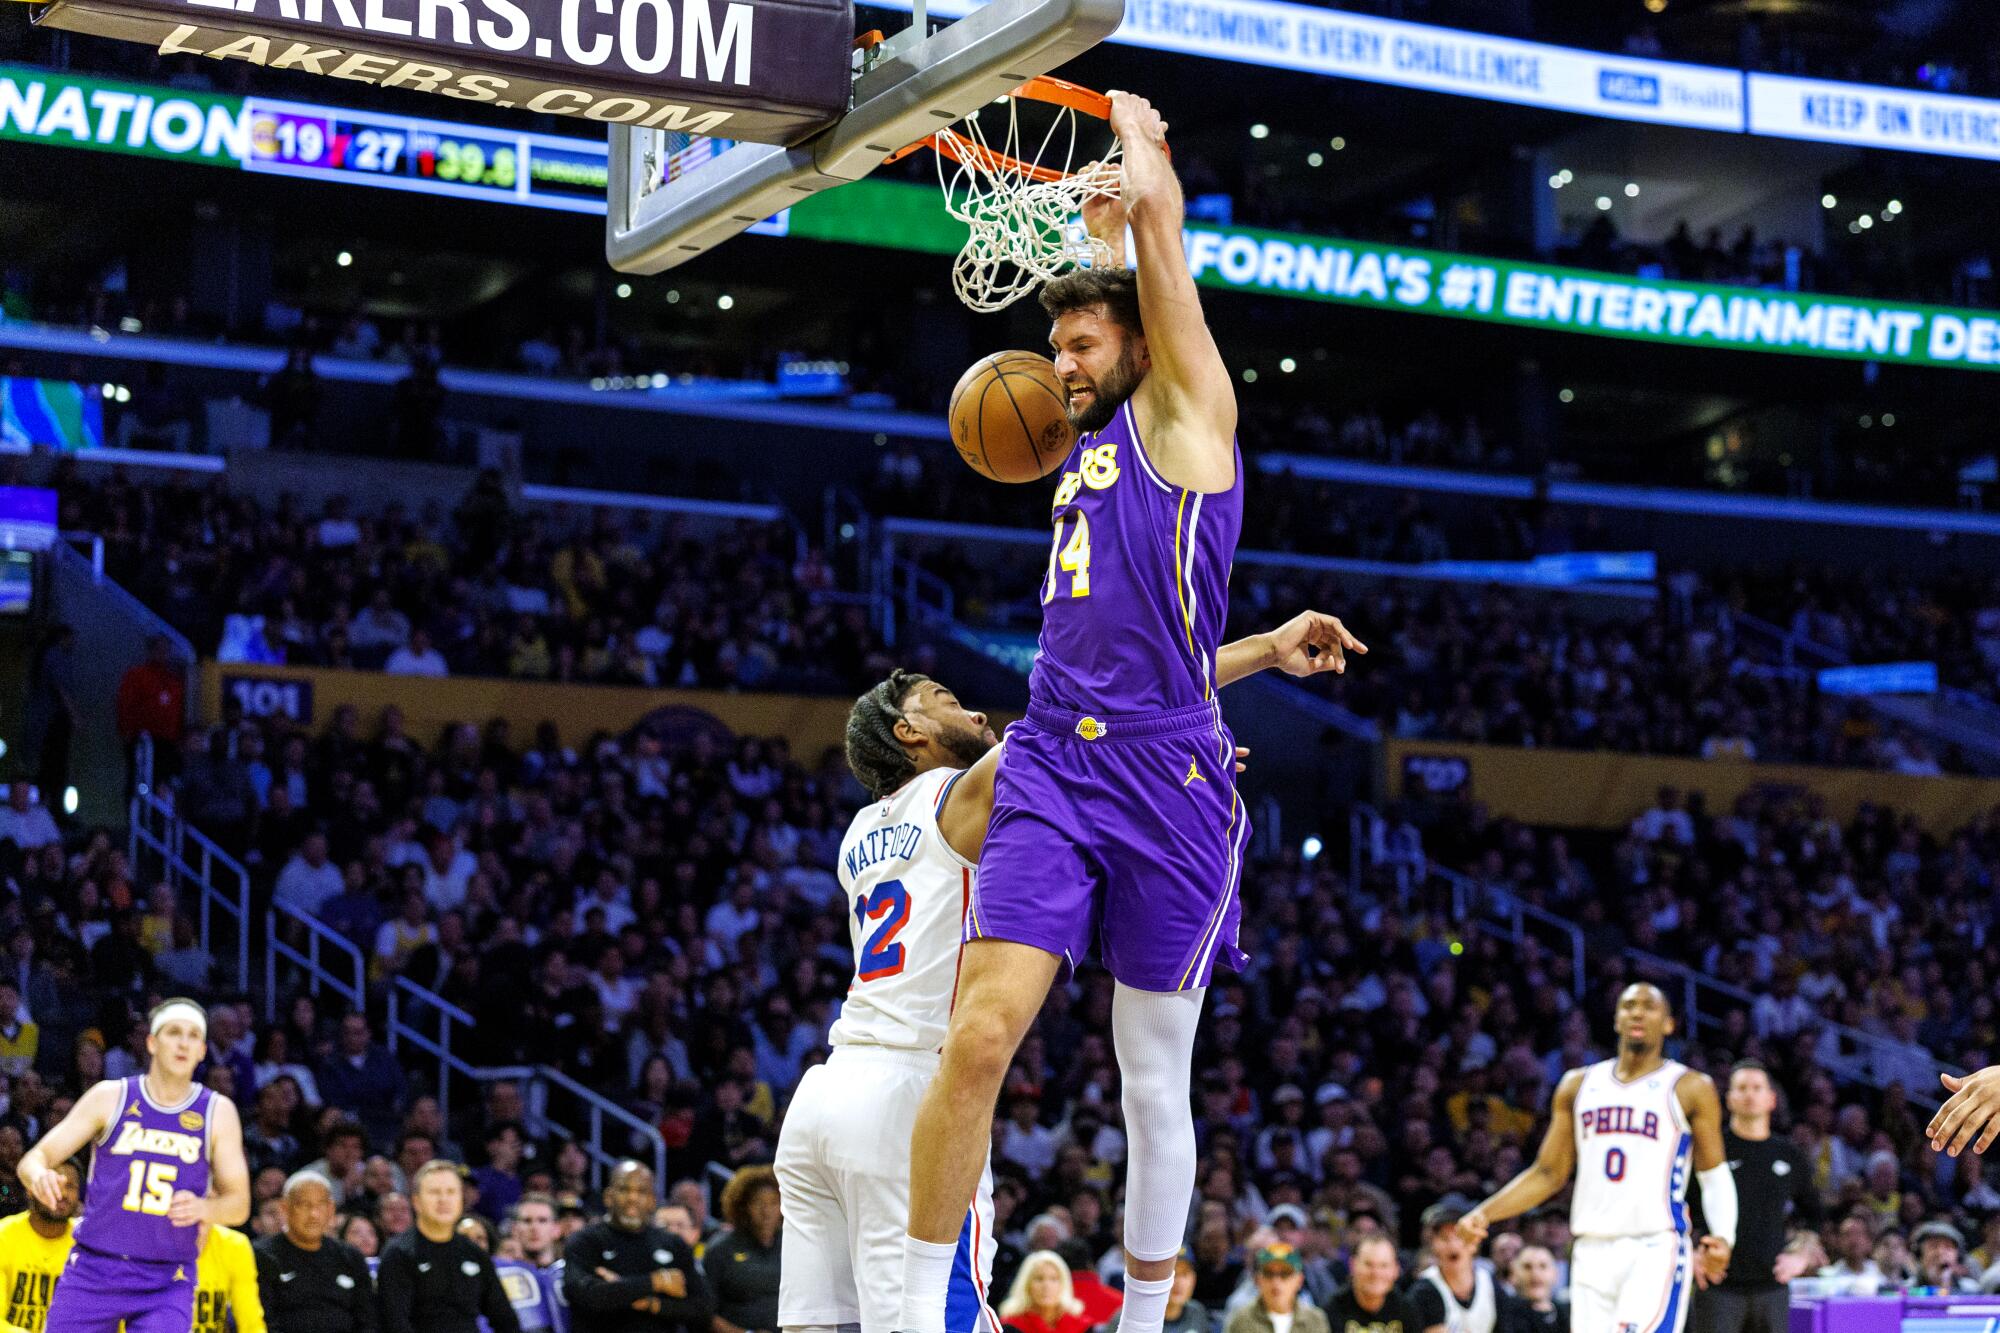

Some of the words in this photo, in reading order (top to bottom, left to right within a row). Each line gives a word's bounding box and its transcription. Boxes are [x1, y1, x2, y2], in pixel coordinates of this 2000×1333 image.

[184, 0, 753, 86] RS.COM
[1126, 0, 1291, 50] VERCOMING
[1301, 22, 1383, 66] EVERY
[1394, 38, 1541, 91] CHALLENGE
[158, 24, 734, 133] LAKERS.COM
[0, 77, 249, 159] NATION
[1803, 95, 1866, 130] KEEP
[1876, 100, 1911, 135] ON
[276, 122, 325, 164] 19
[354, 130, 405, 173] 27
[1440, 264, 1498, 315] #1
[1504, 270, 1923, 356] ENTERTAINMENT
[110, 1120, 204, 1165] LAKERS
[1581, 1105, 1659, 1141] PHILA
[121, 1159, 179, 1217] 15
[1604, 1147, 1627, 1183] 0
